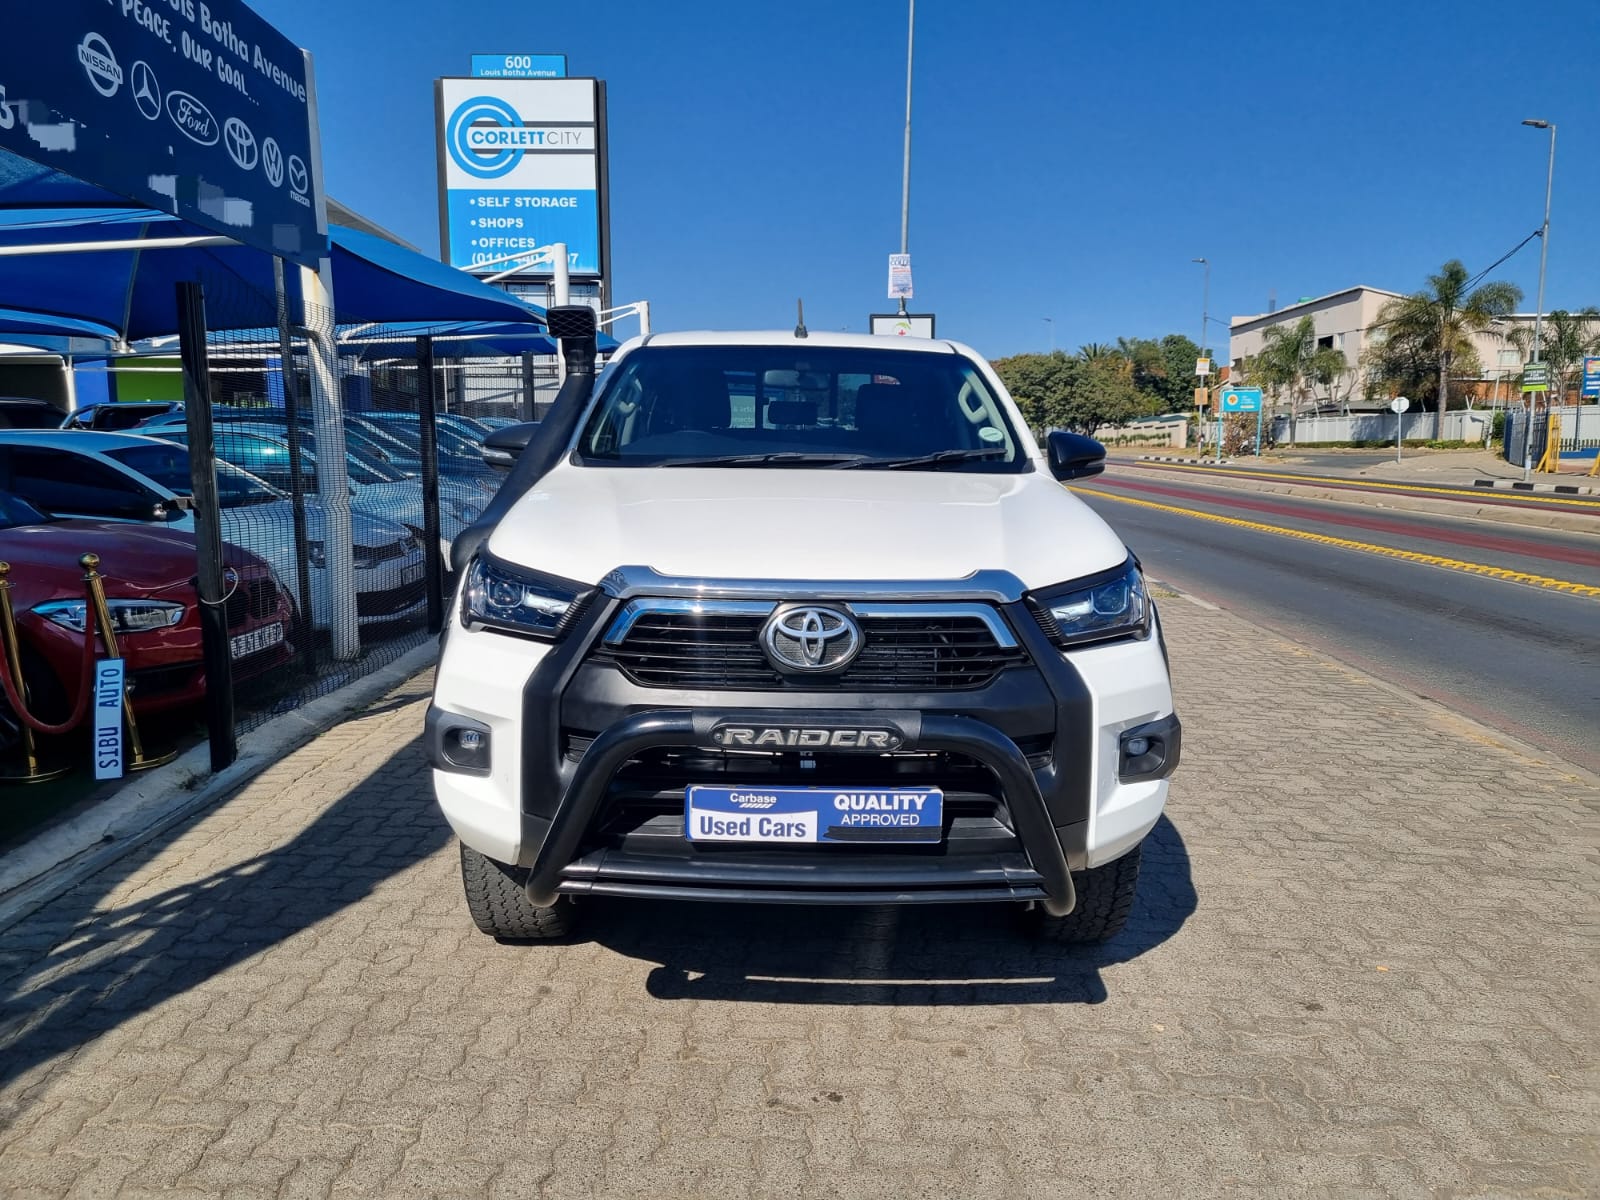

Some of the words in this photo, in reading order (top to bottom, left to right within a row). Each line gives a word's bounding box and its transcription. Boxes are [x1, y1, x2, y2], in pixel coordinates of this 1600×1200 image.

[182, 31, 212, 71] OUR
[200, 1, 249, 62] Botha
[253, 45, 306, 103] Avenue
[80, 50, 121, 78] NISSAN
[505, 56, 532, 69] 600
[480, 68, 501, 76] Louis
[527, 69, 557, 77] Avenue
[177, 98, 210, 137] Ford
[471, 131, 545, 145] CORLETT
[547, 131, 582, 145] CITY
[478, 197, 511, 208] SELF
[515, 197, 578, 208] STORAGE
[479, 218, 524, 229] SHOPS
[479, 238, 536, 249] OFFICES
[98, 668, 121, 708] AUTO
[722, 728, 890, 748] RAIDER
[98, 726, 120, 769] SIBU
[729, 793, 777, 804] Carbase
[833, 794, 928, 811] QUALITY
[699, 816, 751, 837] Used
[758, 817, 807, 838] Cars
[840, 814, 920, 826] APPROVED
